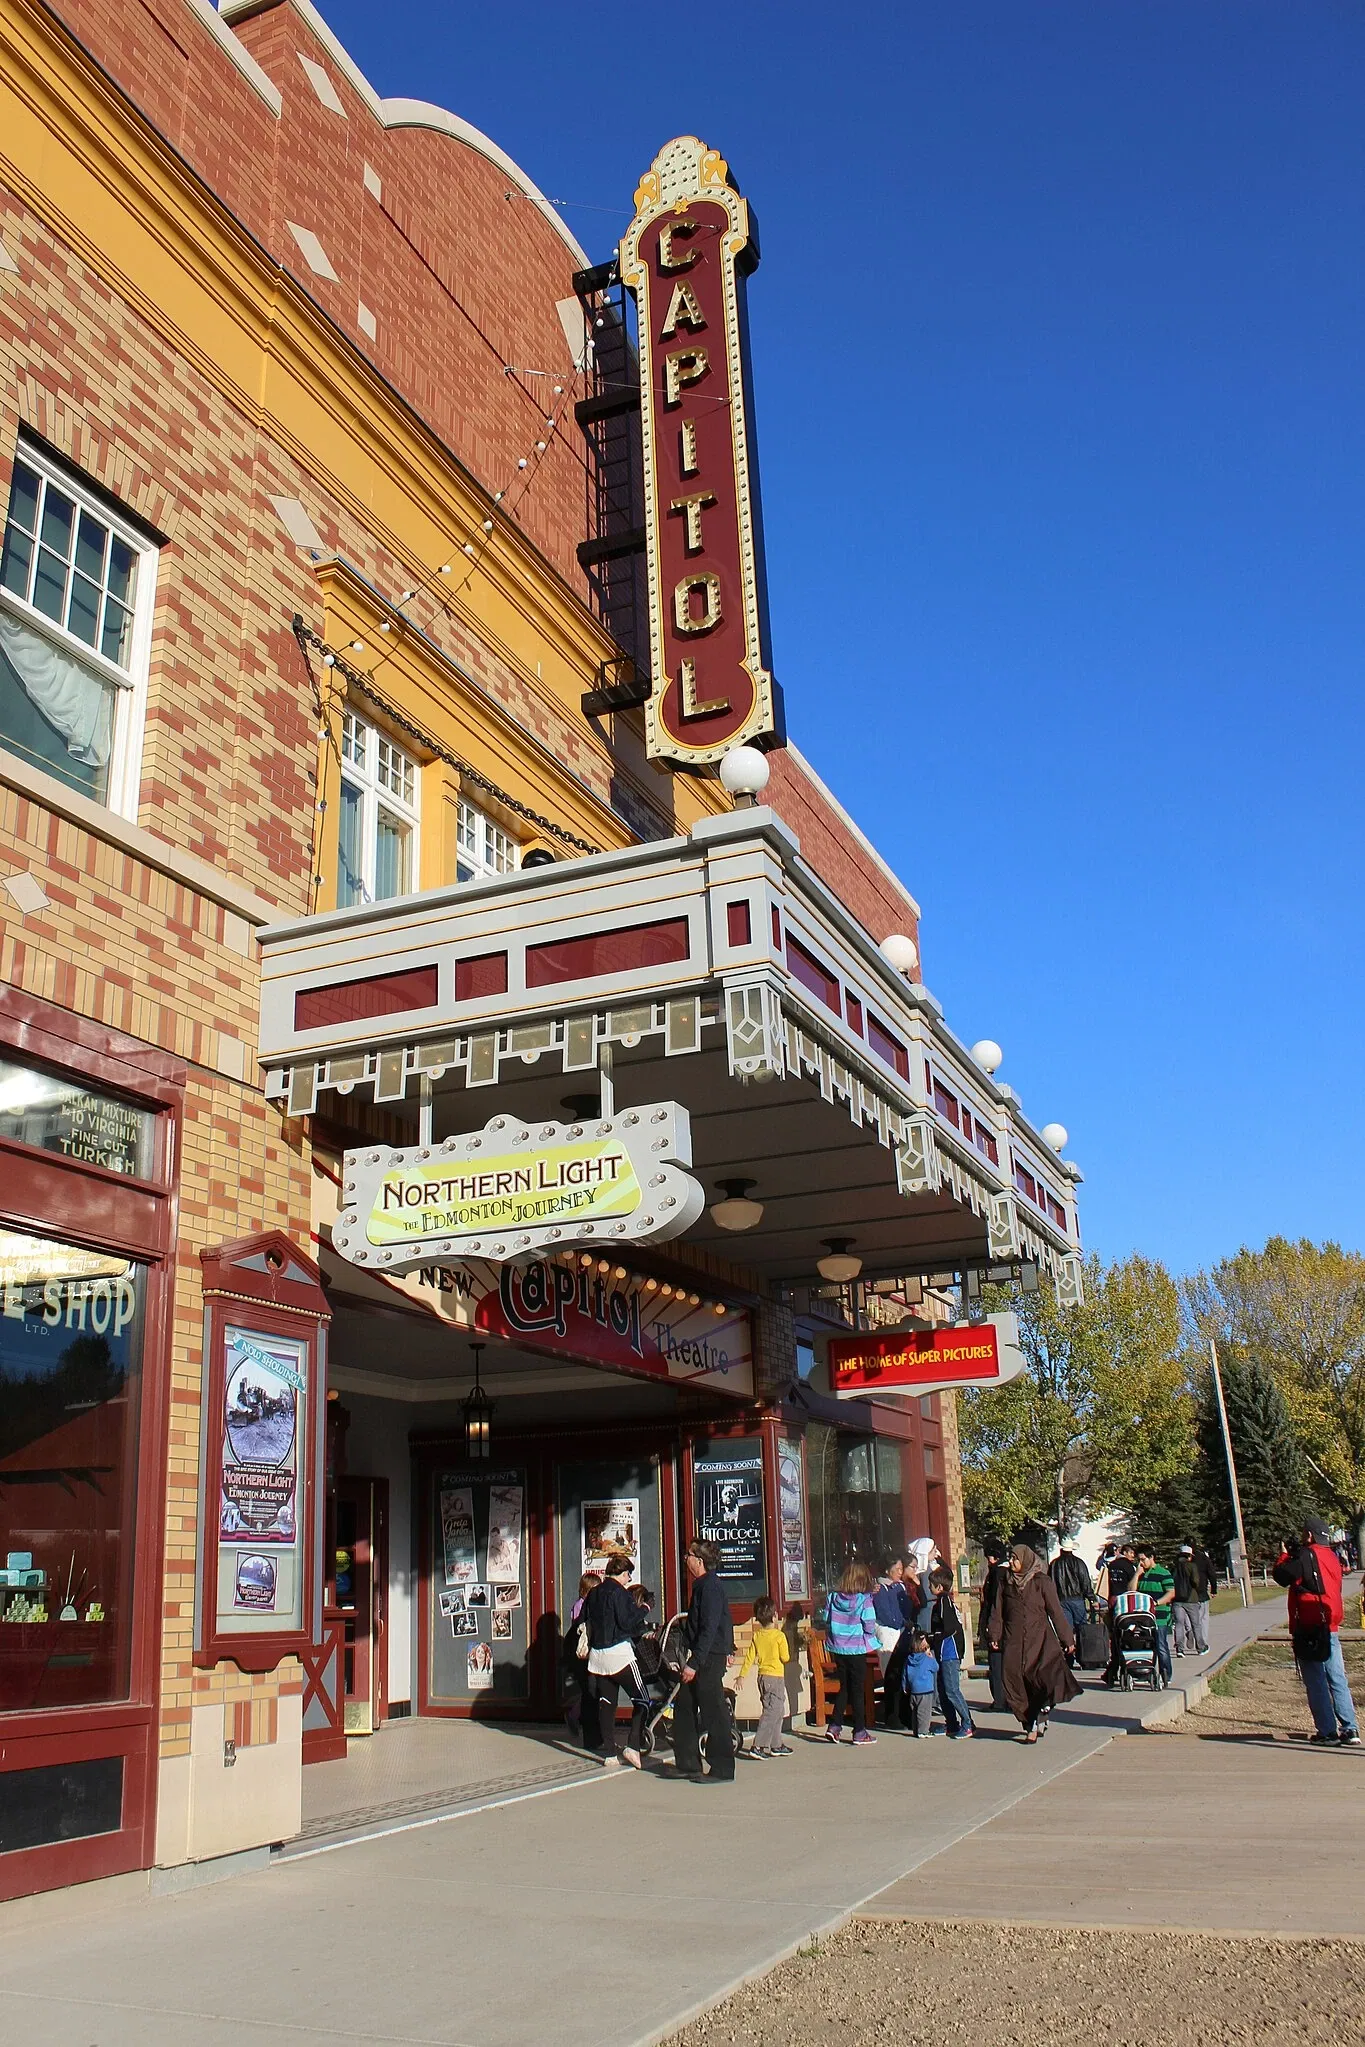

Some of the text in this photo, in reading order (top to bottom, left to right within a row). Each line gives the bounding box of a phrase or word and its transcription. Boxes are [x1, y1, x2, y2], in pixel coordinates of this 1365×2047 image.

[659, 219, 731, 717] CAPITOL
[59, 1087, 142, 1128] BALKAN MIXTURE
[71, 1127, 128, 1155] FINE CUT
[88, 1113, 137, 1143] VIRGINIA
[60, 1138, 135, 1175] TURKISH
[382, 1154, 624, 1210] NORTHERN LIGHT
[403, 1187, 598, 1232] THE EDMONTON JOURNEY
[43, 1278, 136, 1338] SHOP
[418, 1259, 729, 1375] NEW Capitol Theatre
[25, 1323, 50, 1336] LTD.
[241, 1341, 262, 1360] NOW
[837, 1344, 993, 1372] THE HOME OF SUPER PICTURES
[223, 1469, 293, 1488] NORTHERN LIGHT
[701, 1460, 756, 1471] COMING SOON!
[229, 1487, 259, 1499] EDMONTON
